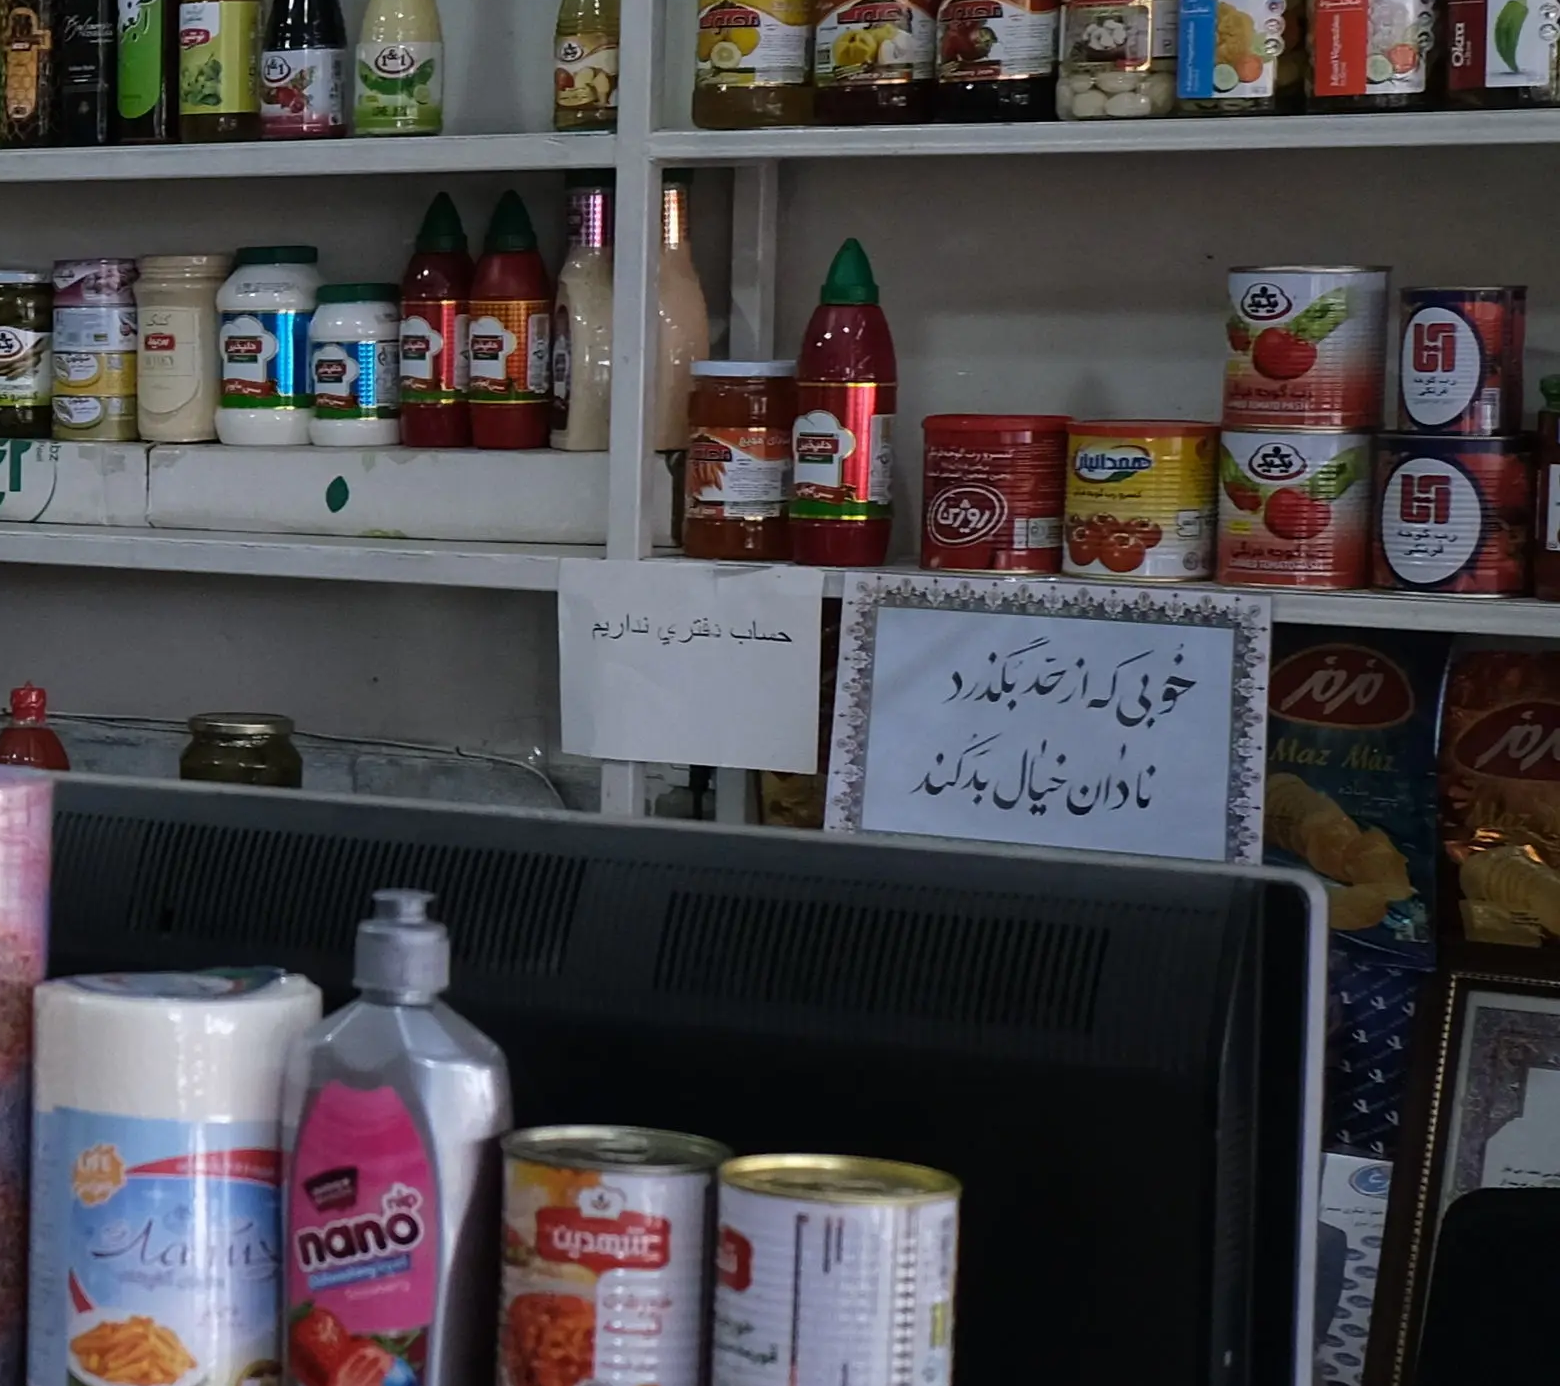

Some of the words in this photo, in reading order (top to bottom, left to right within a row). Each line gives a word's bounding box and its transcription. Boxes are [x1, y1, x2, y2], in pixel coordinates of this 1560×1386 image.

[1451, 22, 1466, 69] Okra
[731, 621, 793, 644] حساب
[1280, 654, 1386, 715] مزمز
[993, 738, 1066, 815] خیال
[1269, 737, 1332, 767] Maz
[1064, 744, 1157, 818] نادان
[299, 1215, 420, 1266] nano
